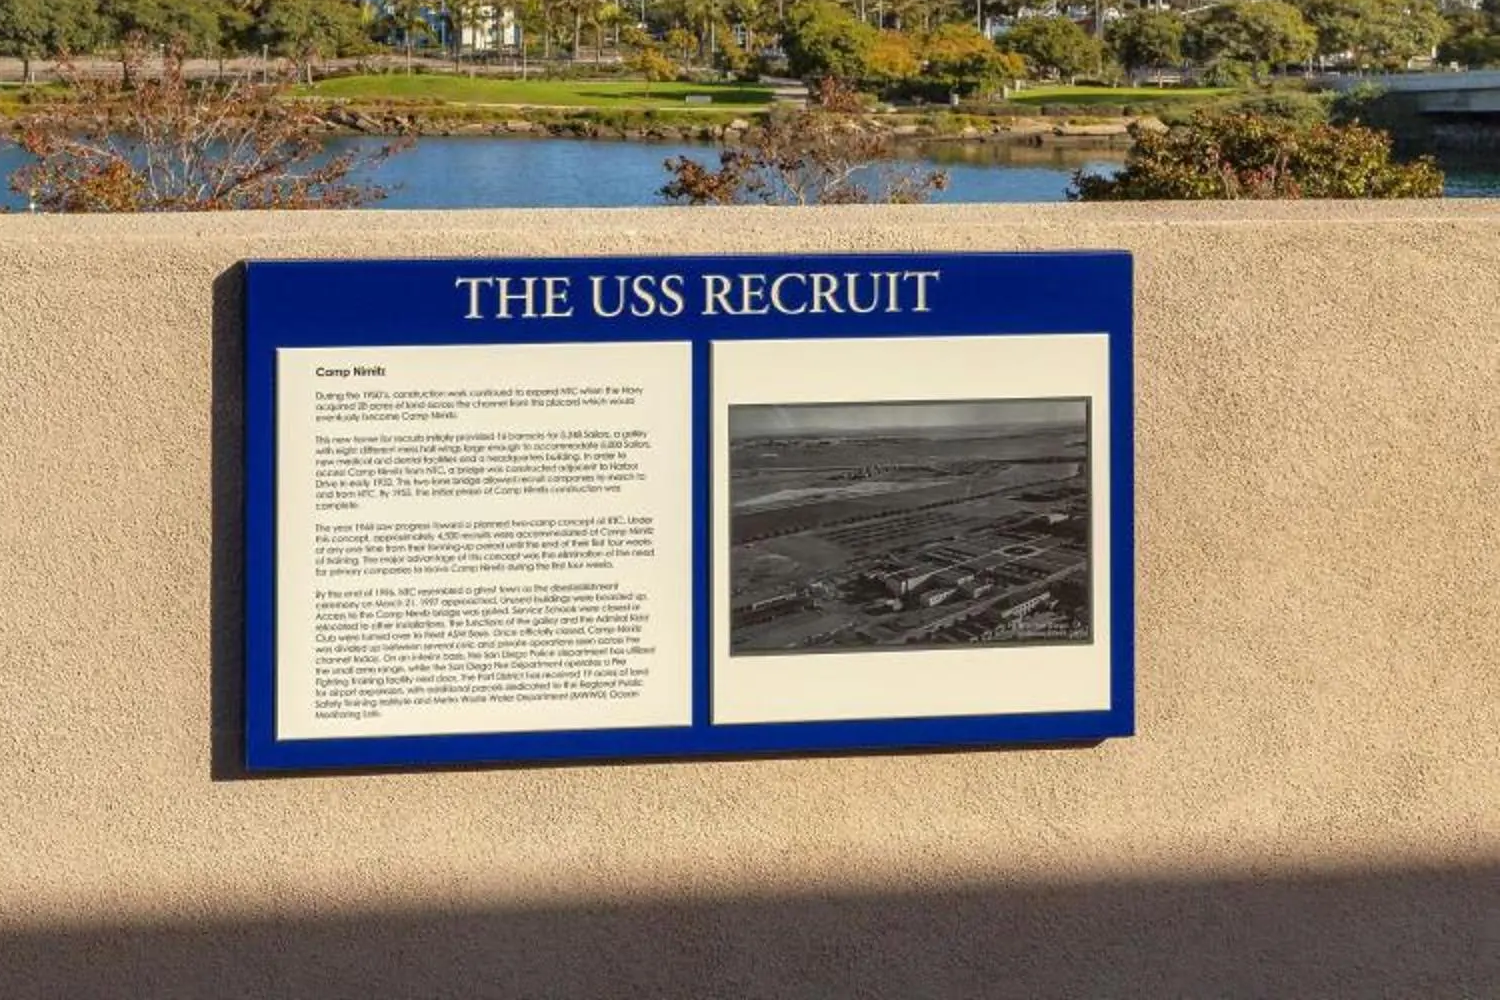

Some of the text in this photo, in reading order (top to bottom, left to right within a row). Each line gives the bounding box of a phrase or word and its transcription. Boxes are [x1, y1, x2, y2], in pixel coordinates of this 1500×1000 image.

[455, 270, 940, 319] THE USS RECRUIT
[315, 365, 386, 377] Camp Nimitz
